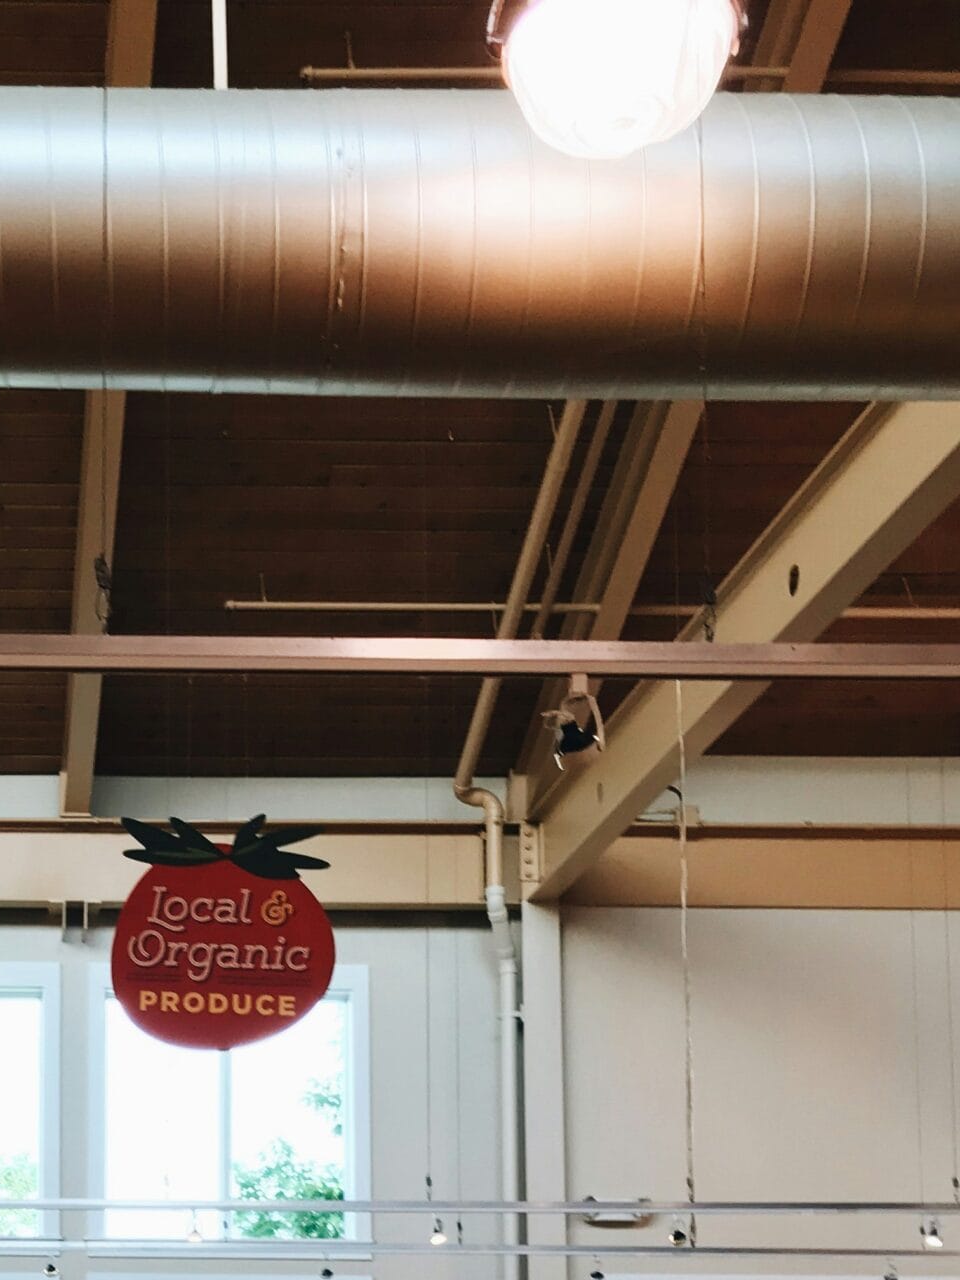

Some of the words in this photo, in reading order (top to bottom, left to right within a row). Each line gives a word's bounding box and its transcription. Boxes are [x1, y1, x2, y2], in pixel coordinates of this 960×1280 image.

[147, 886, 252, 932] Local
[260, 889, 294, 927] &
[128, 929, 310, 981] Organic
[139, 989, 297, 1017] PRODUCE
